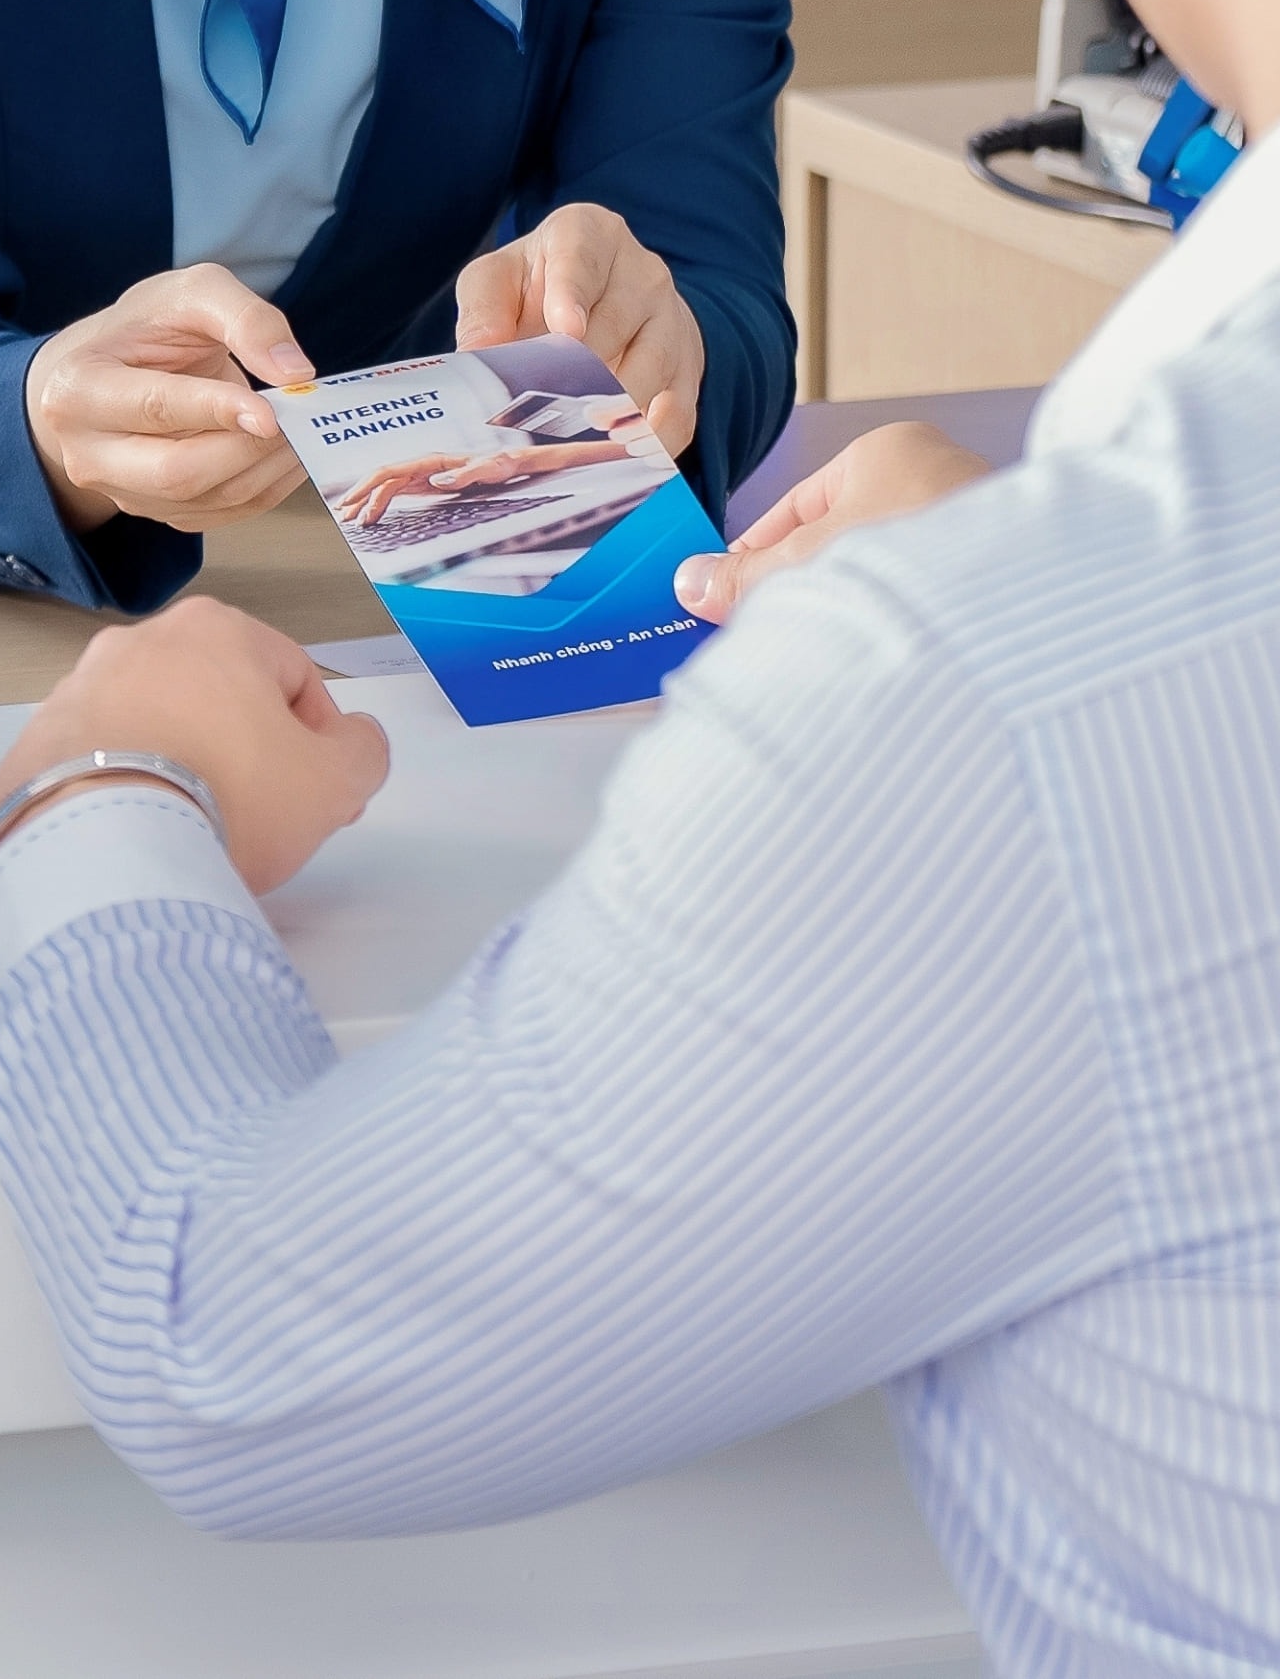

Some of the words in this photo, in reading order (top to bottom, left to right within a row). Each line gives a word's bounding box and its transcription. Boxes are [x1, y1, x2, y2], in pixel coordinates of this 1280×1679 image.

[322, 358, 447, 386] VIETBANK
[310, 390, 439, 428] INTERNET
[321, 407, 445, 445] BANKING
[492, 650, 554, 671] Nhanh
[556, 638, 614, 659] chóng
[628, 628, 653, 643] An
[654, 617, 698, 636] toàn
